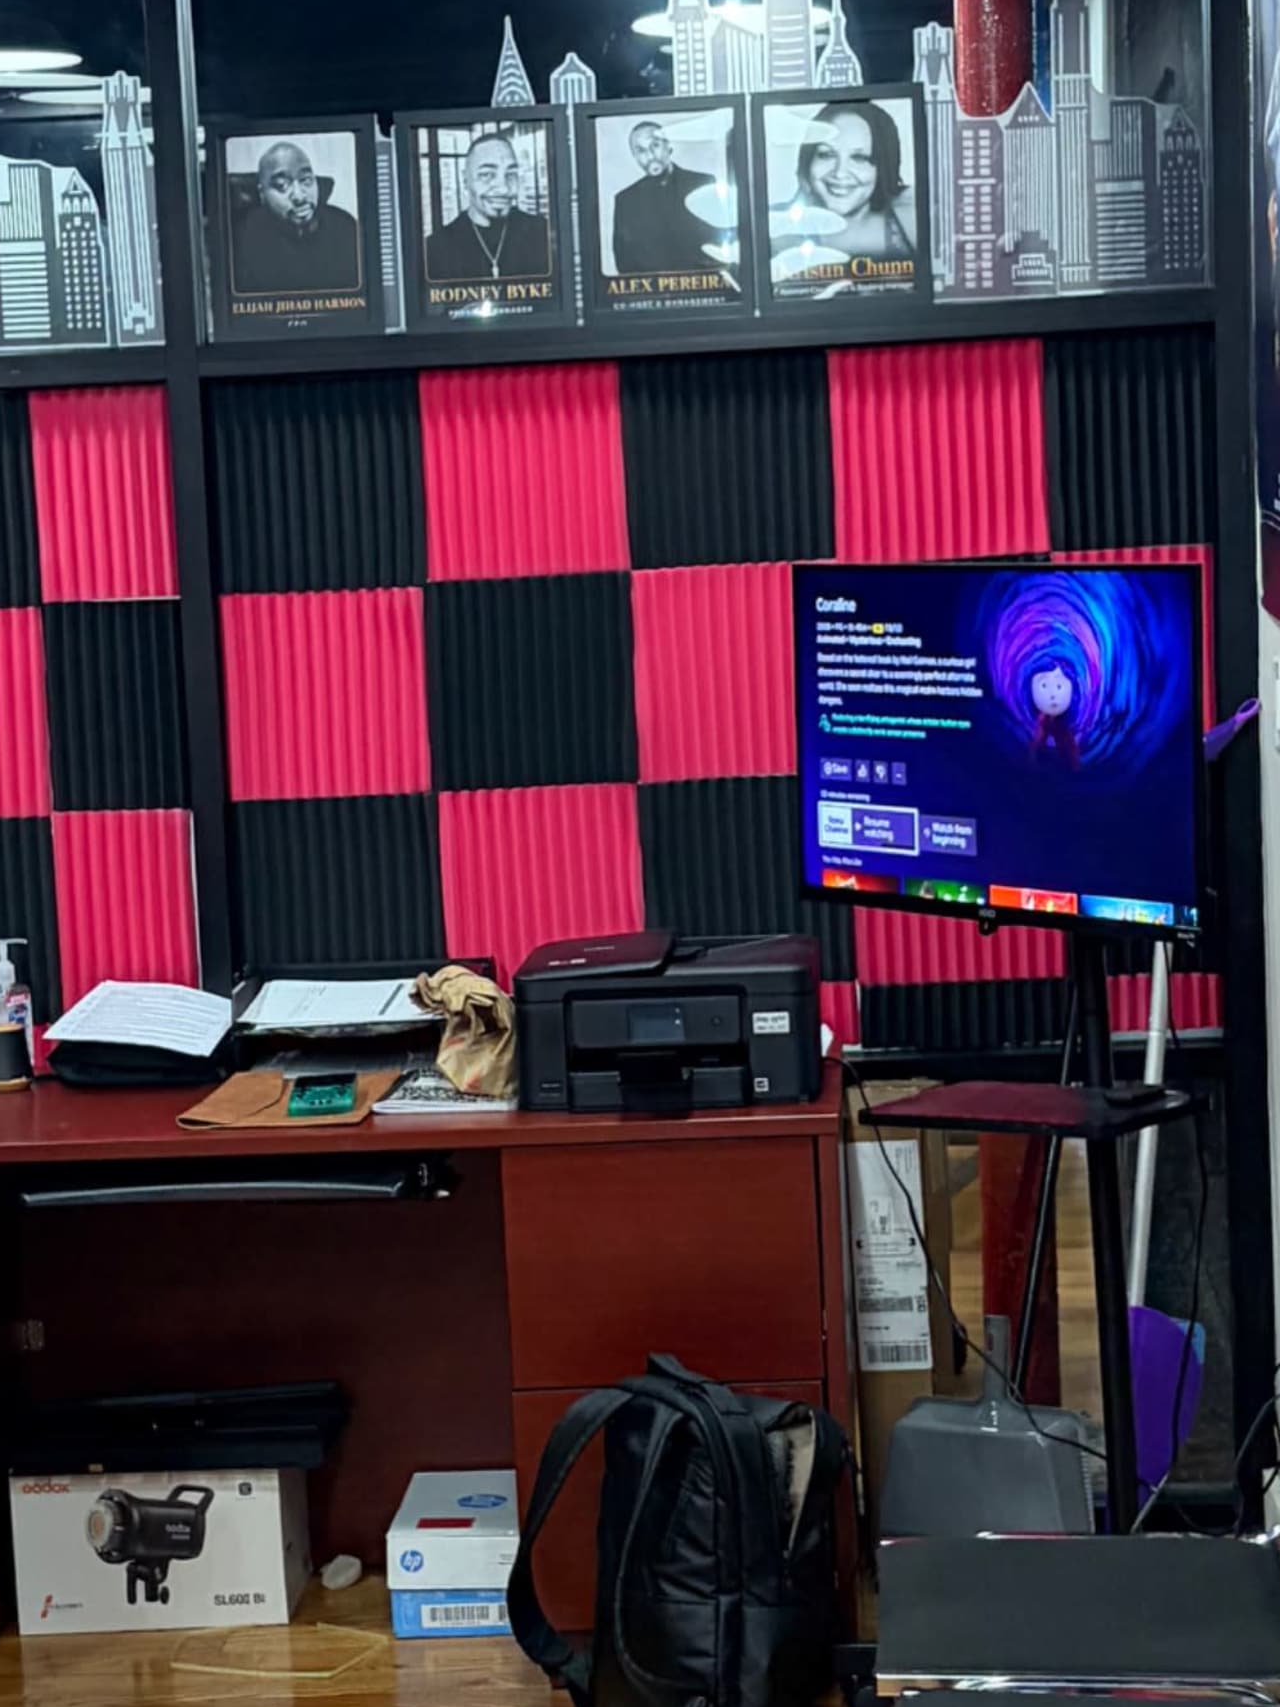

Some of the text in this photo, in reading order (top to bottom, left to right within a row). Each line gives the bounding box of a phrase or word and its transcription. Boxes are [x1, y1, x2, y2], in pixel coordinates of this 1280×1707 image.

[851, 256, 914, 277] Chunn
[429, 282, 553, 303] RODNEY BYKE
[607, 278, 654, 295] ALEX
